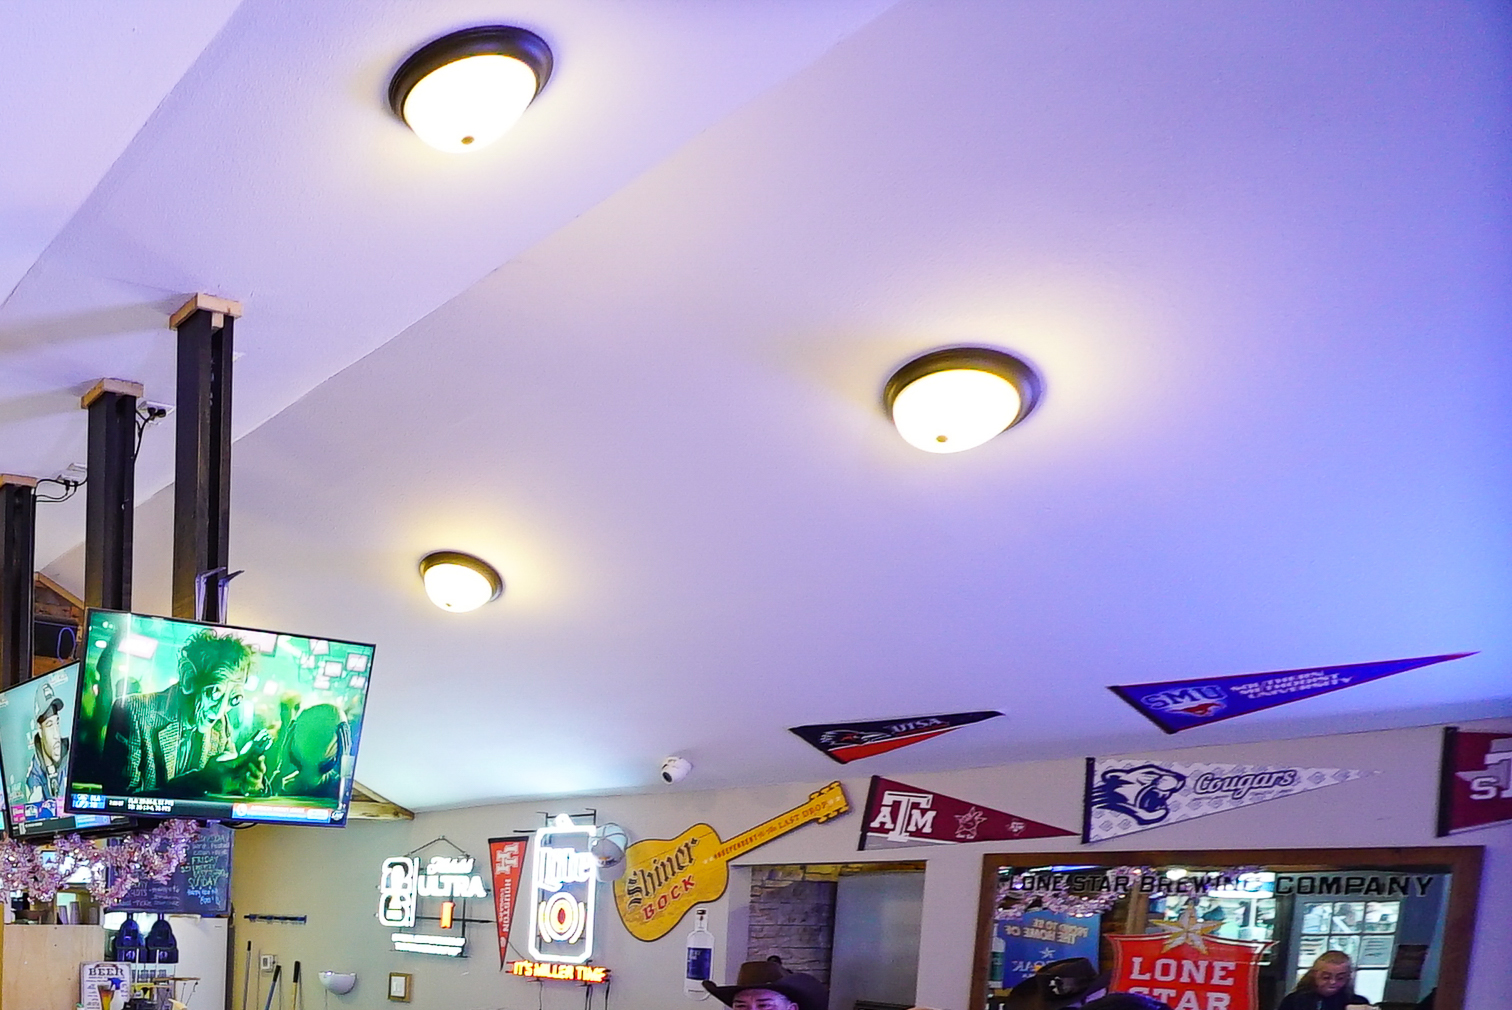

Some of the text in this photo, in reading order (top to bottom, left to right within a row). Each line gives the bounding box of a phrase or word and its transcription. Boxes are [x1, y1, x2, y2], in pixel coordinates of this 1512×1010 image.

[1142, 685, 1226, 709] SMU
[891, 717, 942, 733] UTSA
[1193, 769, 1297, 800] Cougars
[778, 813, 800, 830] LAST
[802, 801, 827, 818] DROP
[417, 874, 488, 898] ULTRA
[628, 842, 695, 908] Shiner
[1009, 876, 1434, 897] LONE STAR BREWING COMPANY
[502, 879, 512, 932] HOUSTON
[642, 875, 695, 920] BOCK
[88, 968, 124, 976] BEER
[513, 960, 607, 982] IT'S MILLER TIME
[1129, 956, 1236, 985] LONE
